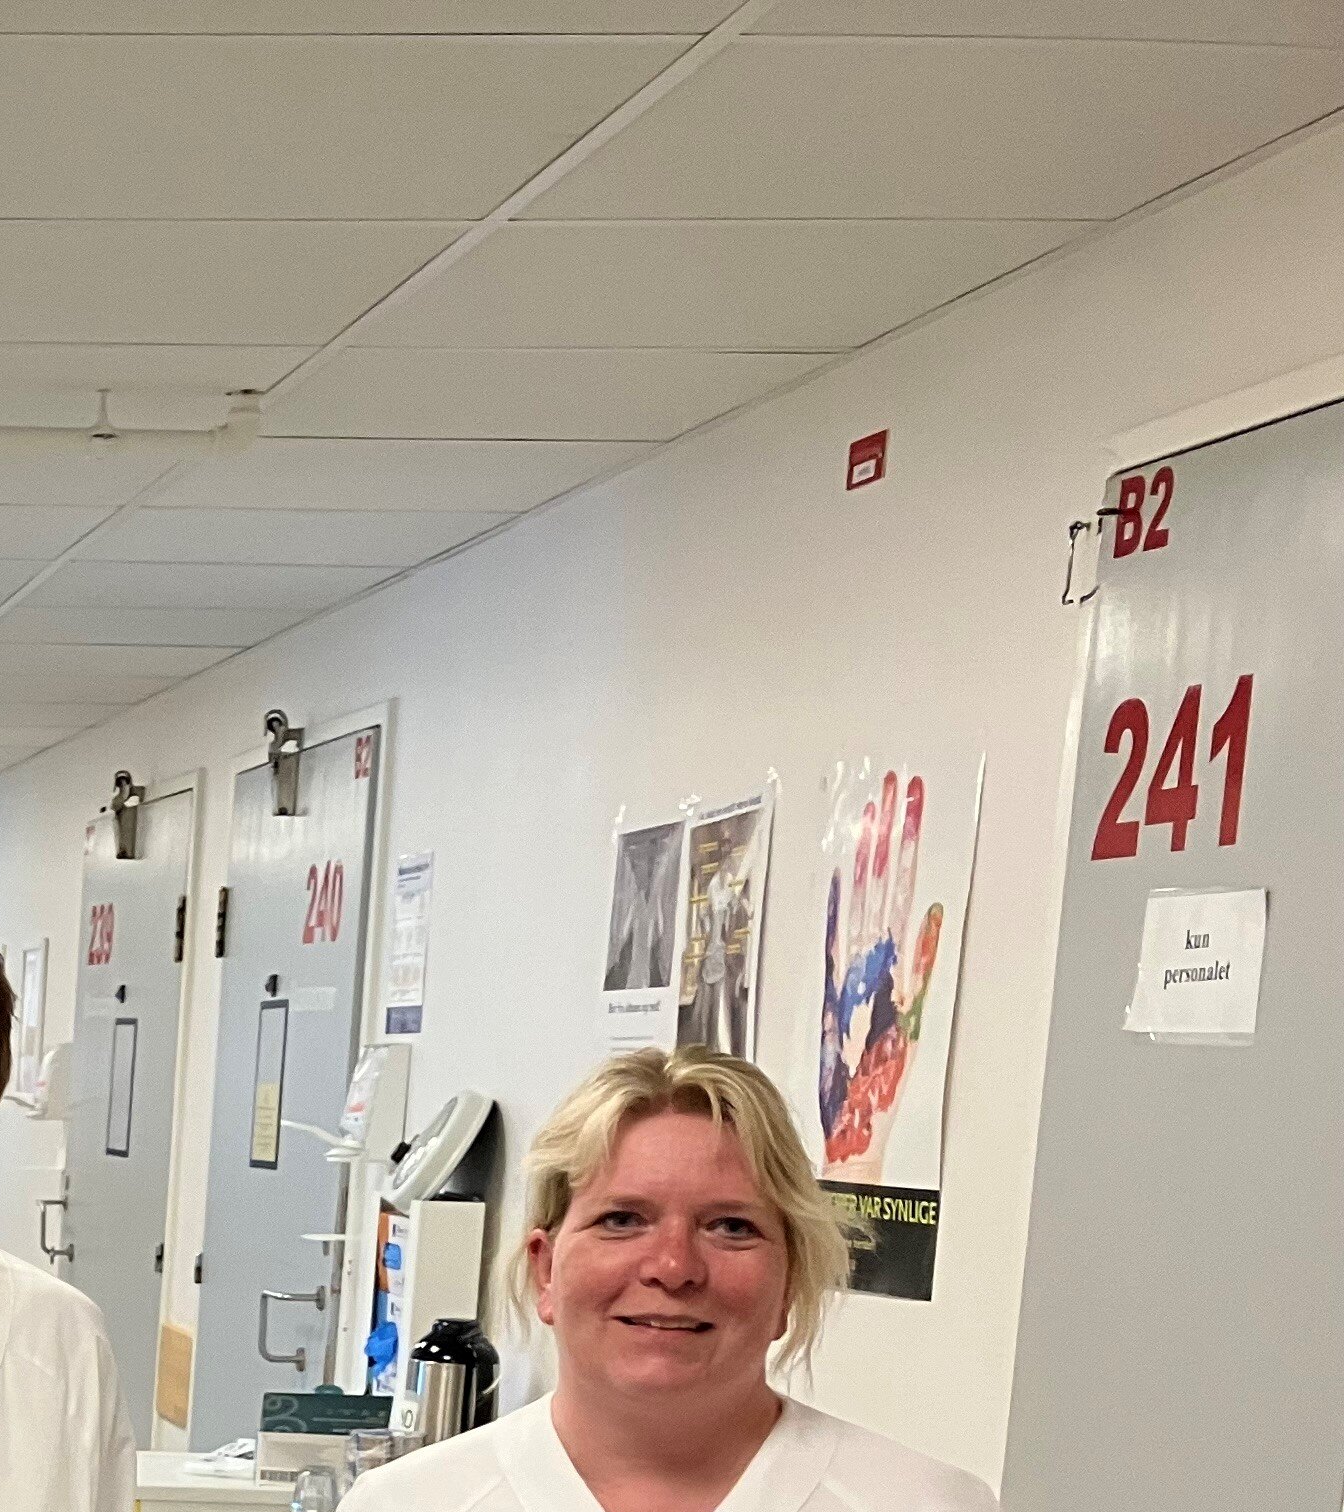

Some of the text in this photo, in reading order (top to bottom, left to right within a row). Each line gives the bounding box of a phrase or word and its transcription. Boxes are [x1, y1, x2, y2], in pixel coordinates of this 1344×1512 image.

[1112, 466, 1175, 560] B2
[1090, 673, 1254, 862] 241
[301, 859, 344, 945] 240
[1184, 929, 1210, 951] kun
[1163, 959, 1231, 991] personalet
[858, 1193, 882, 1220] VAR
[882, 1196, 938, 1225] SYNLIGE
